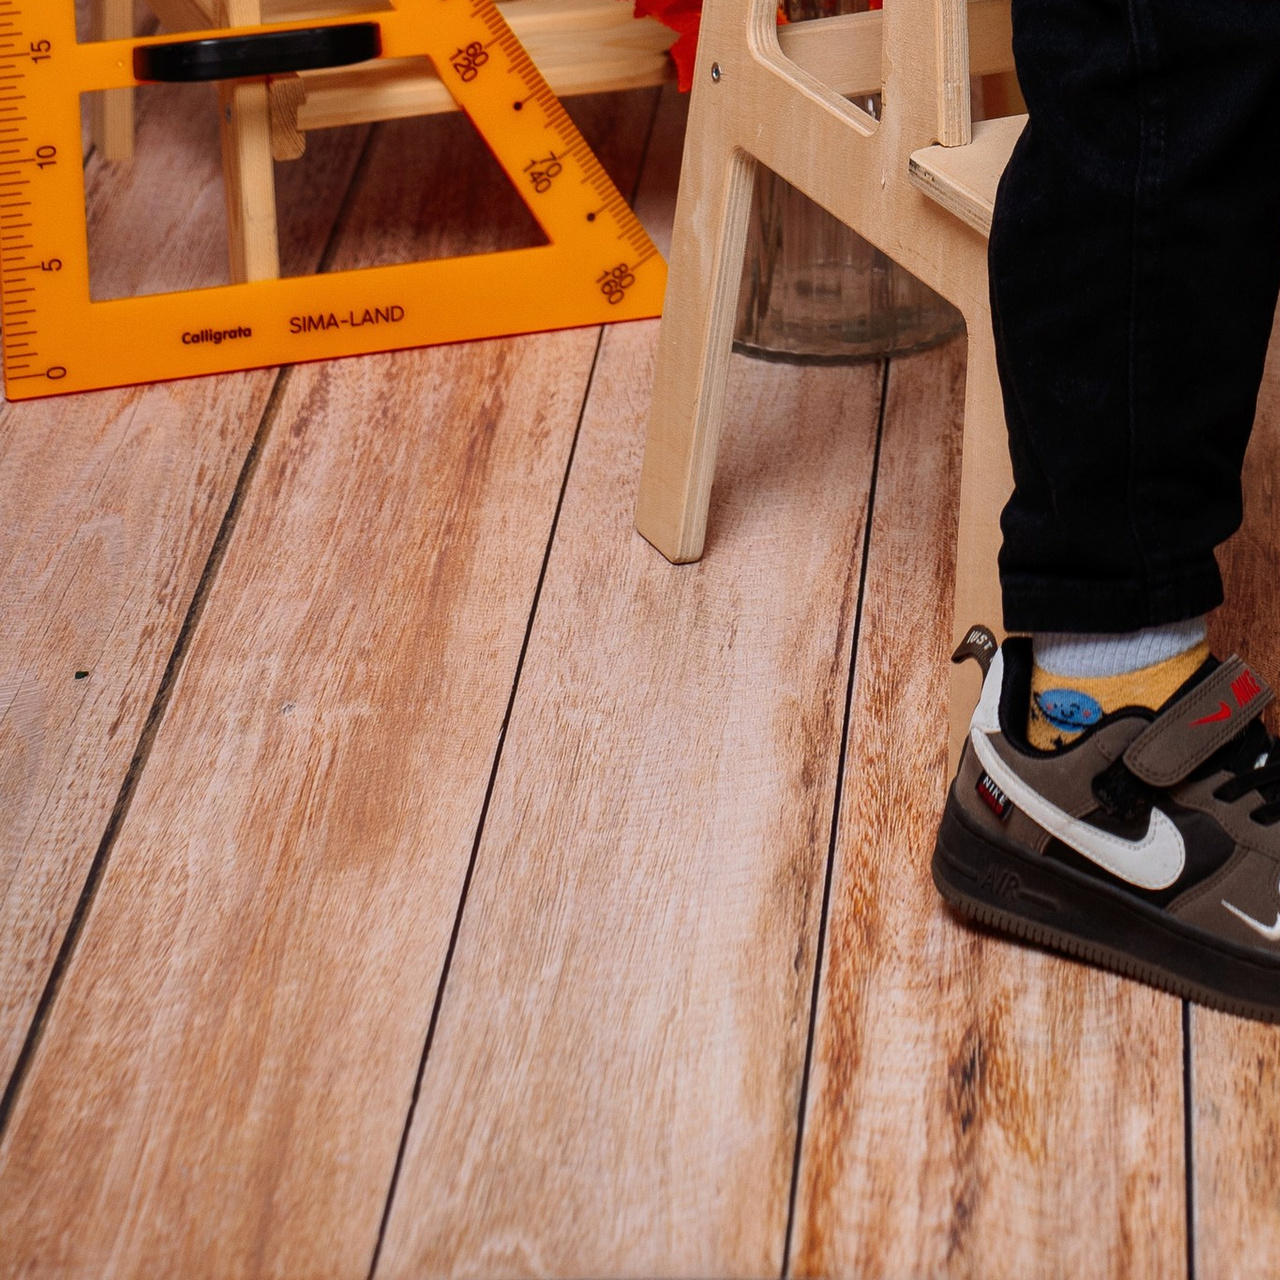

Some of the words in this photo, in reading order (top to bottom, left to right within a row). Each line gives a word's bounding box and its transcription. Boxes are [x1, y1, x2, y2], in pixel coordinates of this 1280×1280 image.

[31, 39, 52, 65] 15
[449, 47, 479, 83] 120
[465, 41, 490, 68] 60
[36, 145, 57, 170] 10
[540, 151, 563, 179] 70
[523, 158, 552, 194] 140
[41, 258, 63, 273] 5
[612, 262, 636, 290] 80
[595, 270, 626, 306] 160
[289, 304, 406, 335] SIMA-LAND
[181, 325, 253, 346] Calligrata
[46, 365, 68, 381] 0
